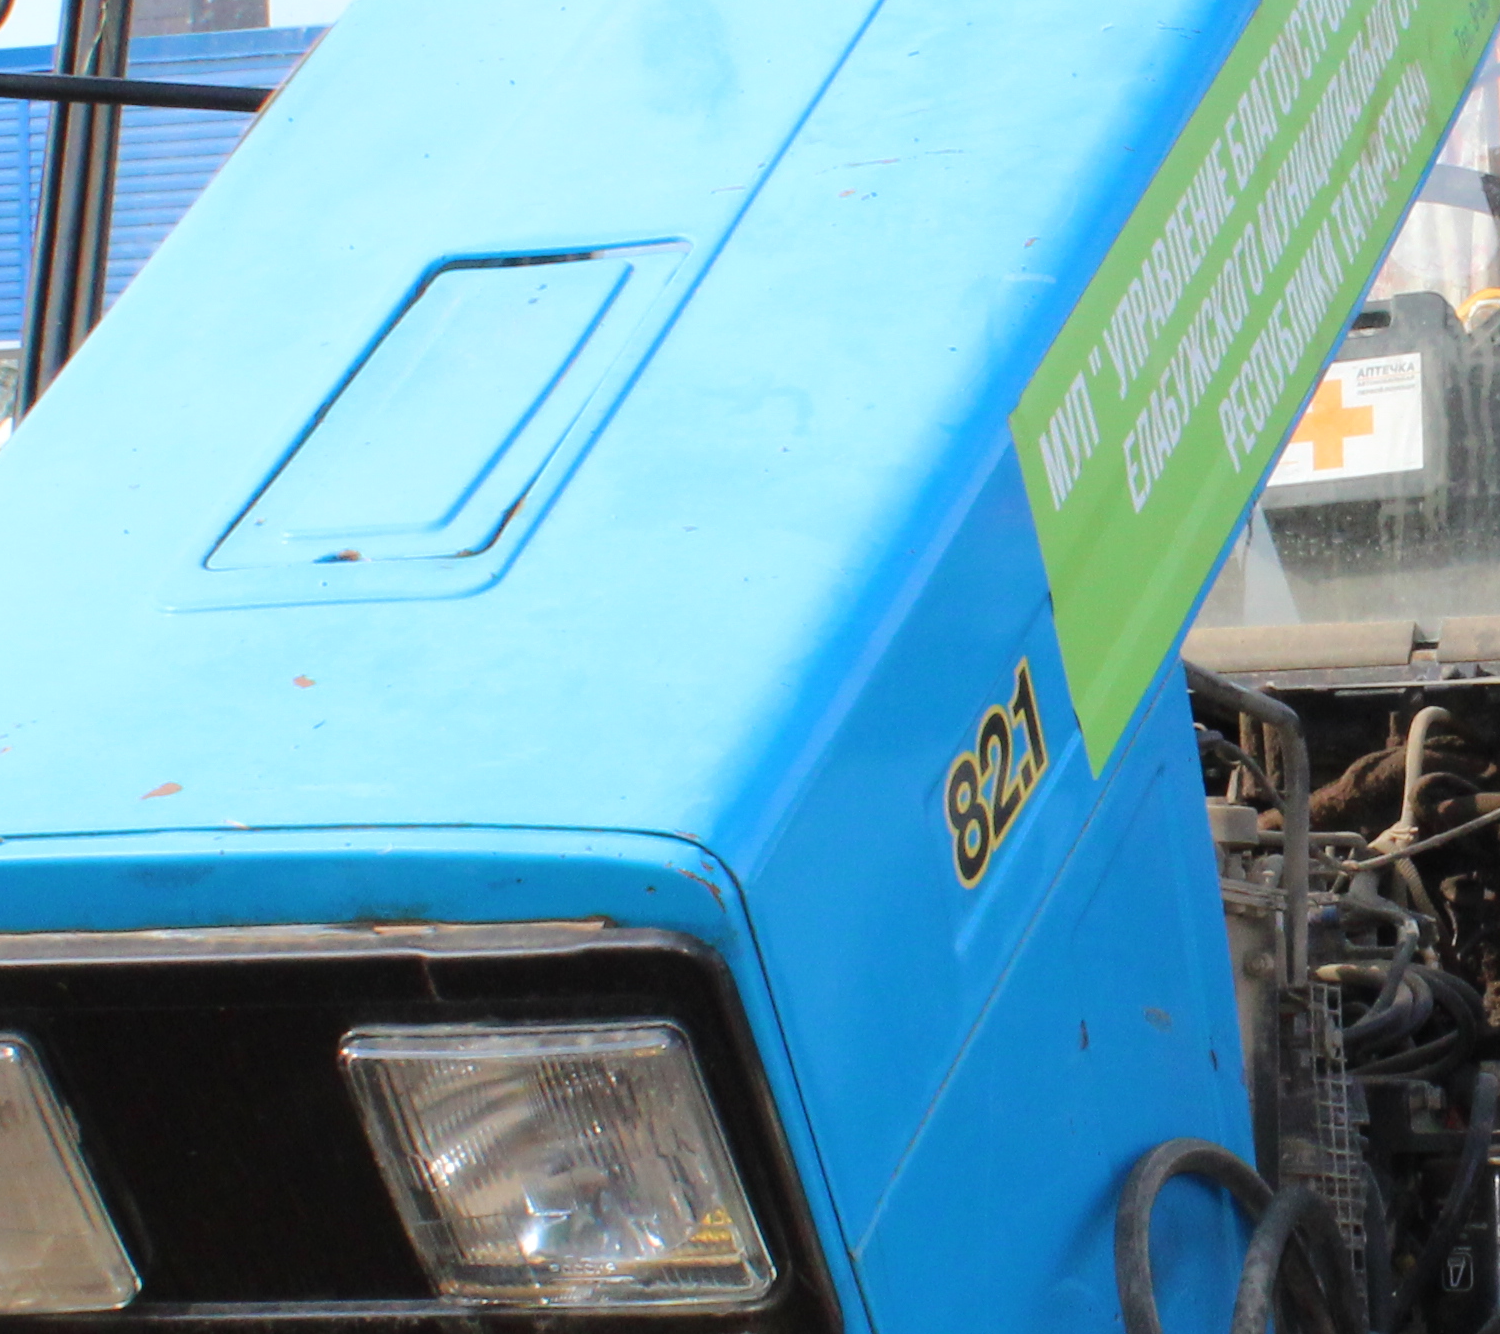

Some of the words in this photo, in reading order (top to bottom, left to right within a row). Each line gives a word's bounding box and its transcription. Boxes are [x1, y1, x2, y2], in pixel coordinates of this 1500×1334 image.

[1038, 371, 1100, 510] МУП
[1102, 137, 1237, 399] УПРАВЛЕНИЕ
[1123, 222, 1265, 512] ЕЛАБУЖСКОГО
[1218, 220, 1345, 471] РЕСПУБЛИКИ
[1356, 362, 1415, 379] АПТЕЧКА
[944, 655, 1049, 889] 82.1
